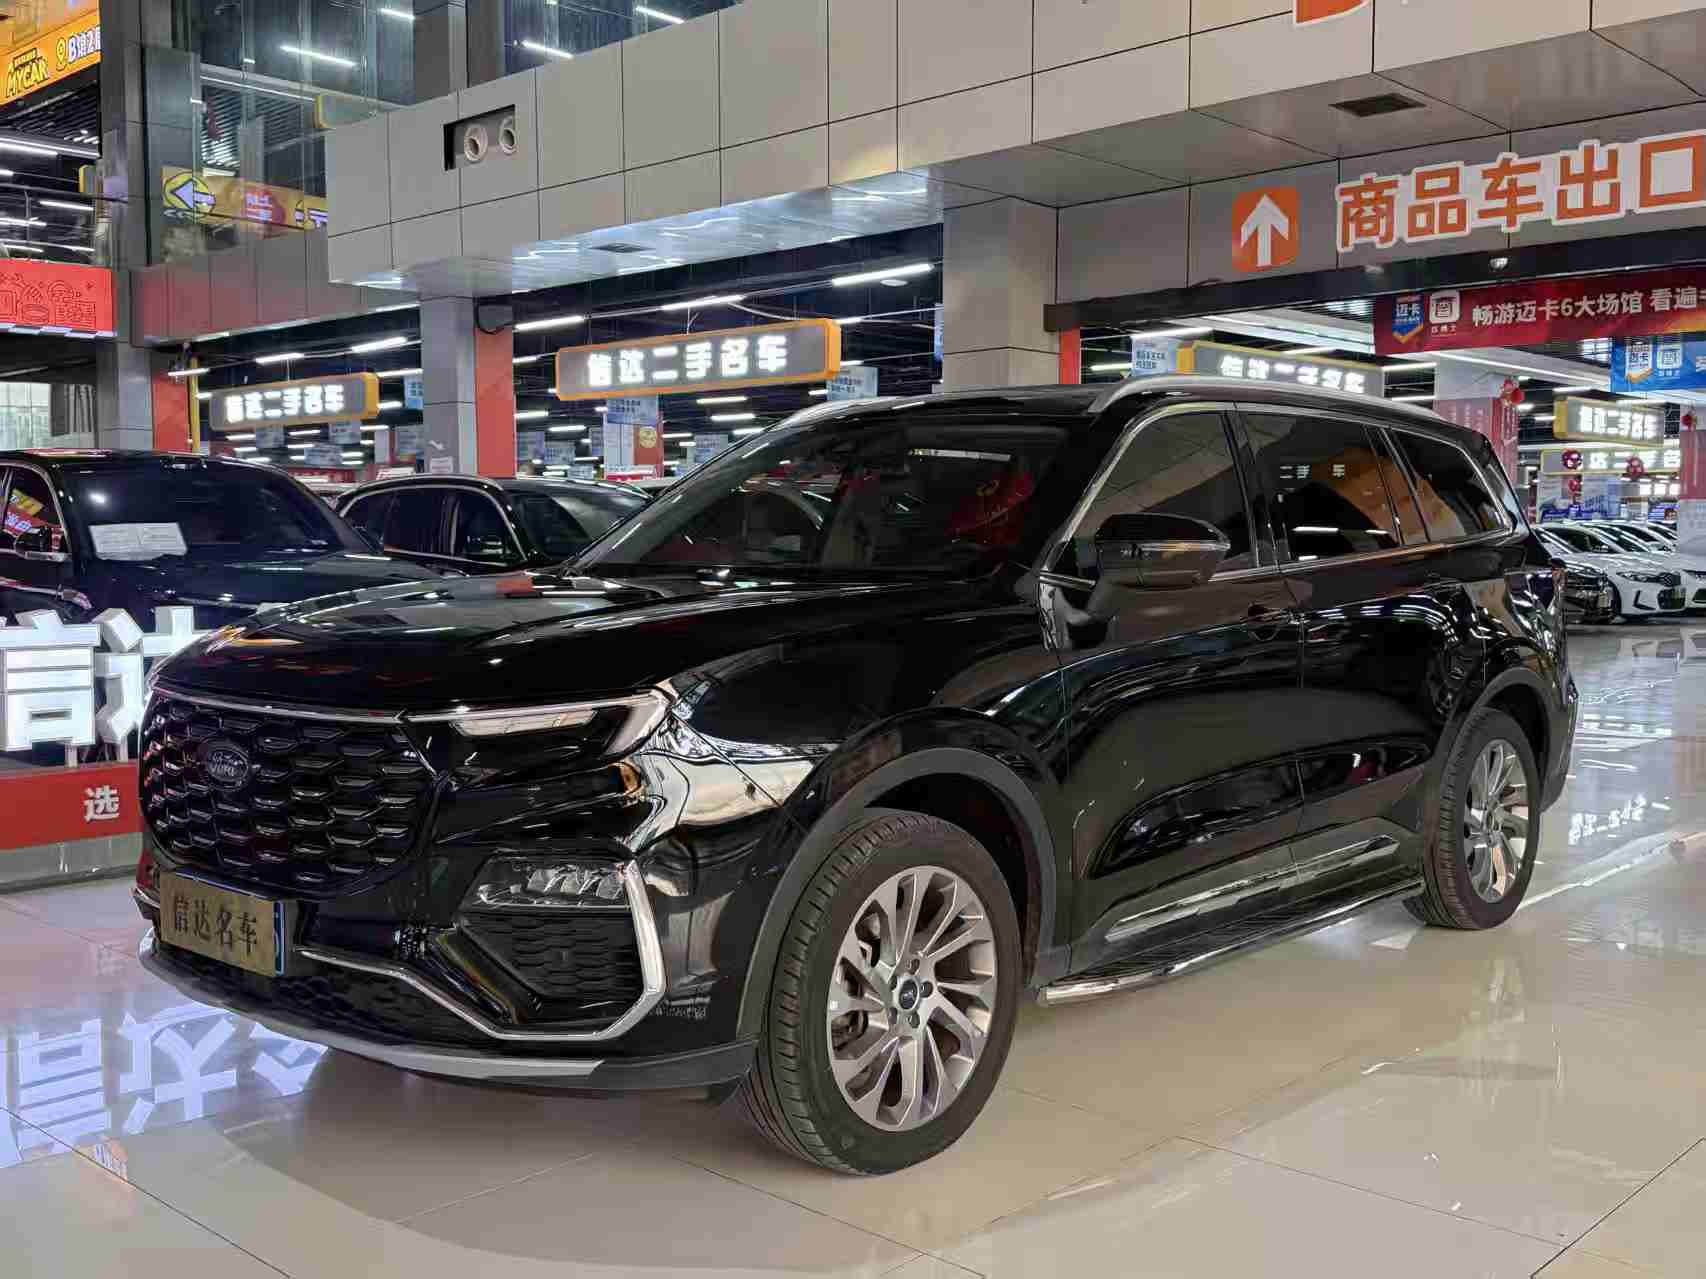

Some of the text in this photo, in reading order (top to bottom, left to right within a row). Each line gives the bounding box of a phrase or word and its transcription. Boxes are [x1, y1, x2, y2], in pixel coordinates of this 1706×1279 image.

[6, 55, 49, 98] MYCAR
[1335, 131, 1706, 252] 商品车出口
[1472, 291, 1643, 327] 畅游迈卡6大场馆
[588, 335, 787, 386] 信达二手名车
[83, 784, 121, 822] 选
[173, 895, 258, 955] 信达名车
